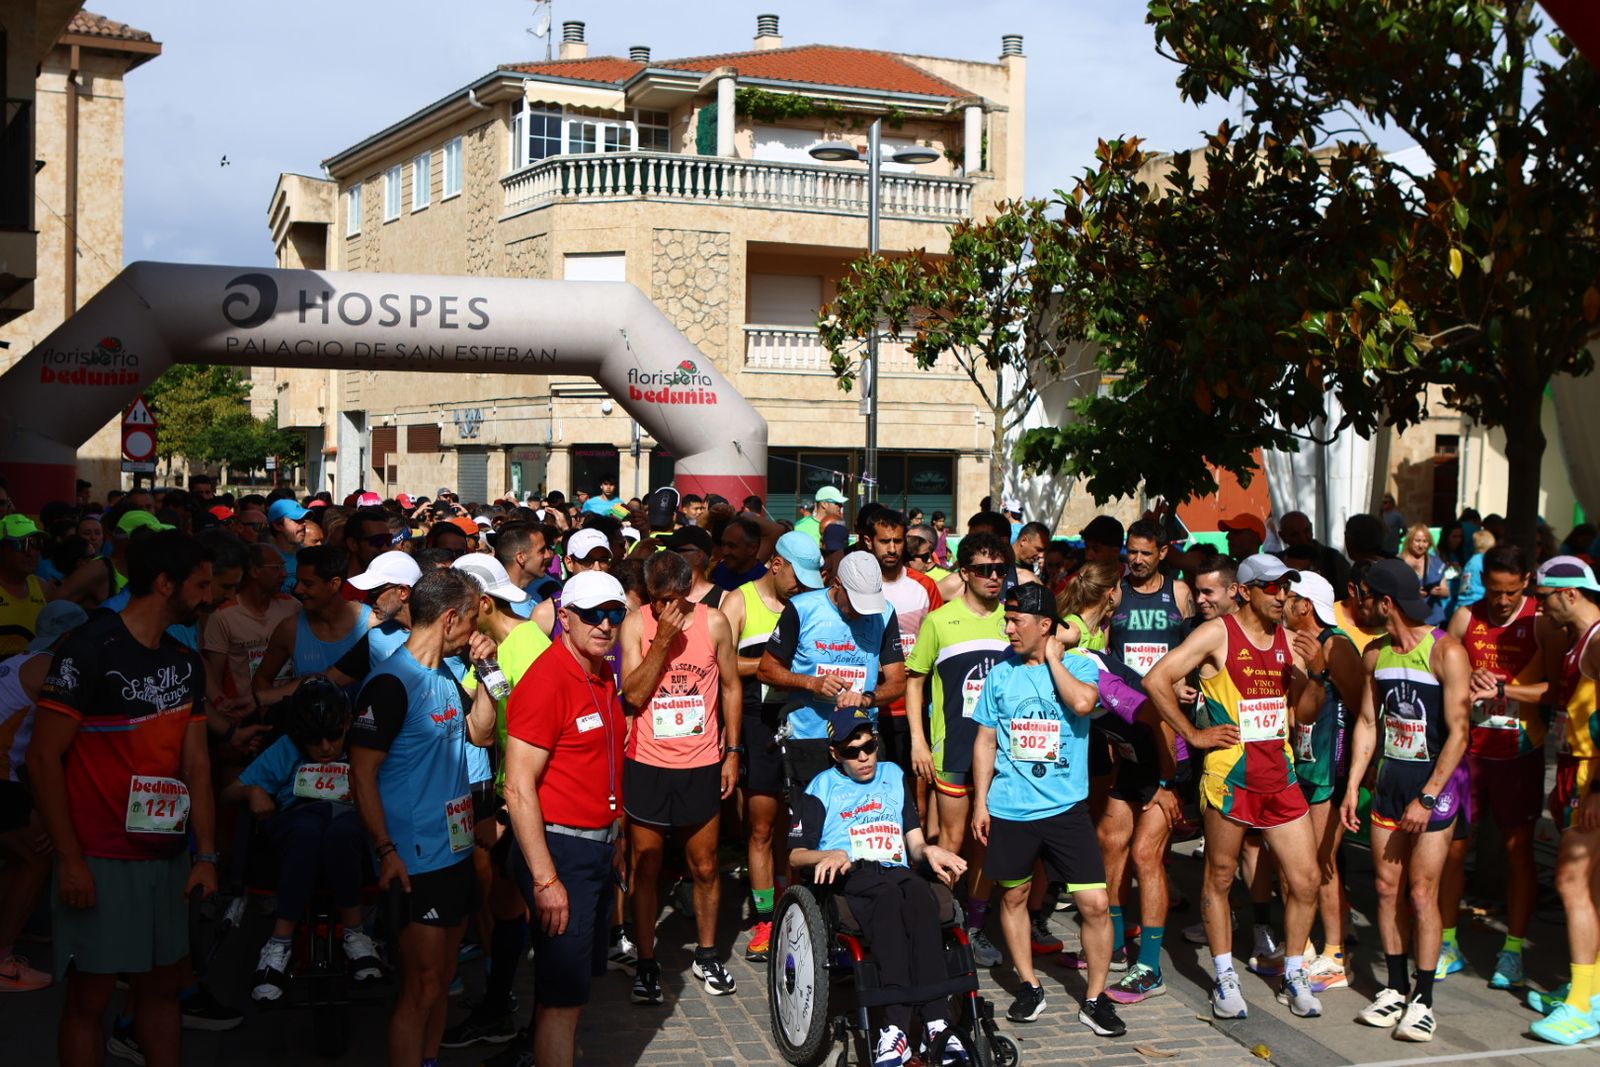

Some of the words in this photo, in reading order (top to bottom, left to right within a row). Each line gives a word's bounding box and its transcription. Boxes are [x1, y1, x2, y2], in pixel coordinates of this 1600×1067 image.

[298, 289, 491, 330] HOSPES
[226, 337, 343, 357] PALACIO
[354, 342, 387, 359] DE
[396, 343, 445, 361] SAN
[455, 345, 557, 363] ESTEBAN
[40, 366, 140, 386] bedunia
[629, 385, 718, 405] bedunia
[1127, 609, 1168, 630] AVS
[1125, 645, 1167, 653] bedunia
[1138, 656, 1154, 666] 79
[817, 666, 865, 678] bedunia
[671, 674, 687, 684] RUN
[1253, 679, 1275, 687] VINO
[1259, 688, 1281, 696] TORO
[653, 699, 703, 710] bedunia
[1240, 700, 1285, 712] bedunia
[1482, 704, 1505, 716] 148
[675, 713, 684, 725] 8
[1254, 714, 1277, 728] 167
[1011, 721, 1059, 732] bedunia
[1020, 735, 1046, 749] 302
[1393, 734, 1413, 749] 297
[133, 779, 188, 795] bedunia
[315, 777, 335, 790] 64
[146, 799, 176, 817] 121
[850, 824, 900, 836] bedunia
[866, 836, 892, 850] 176
